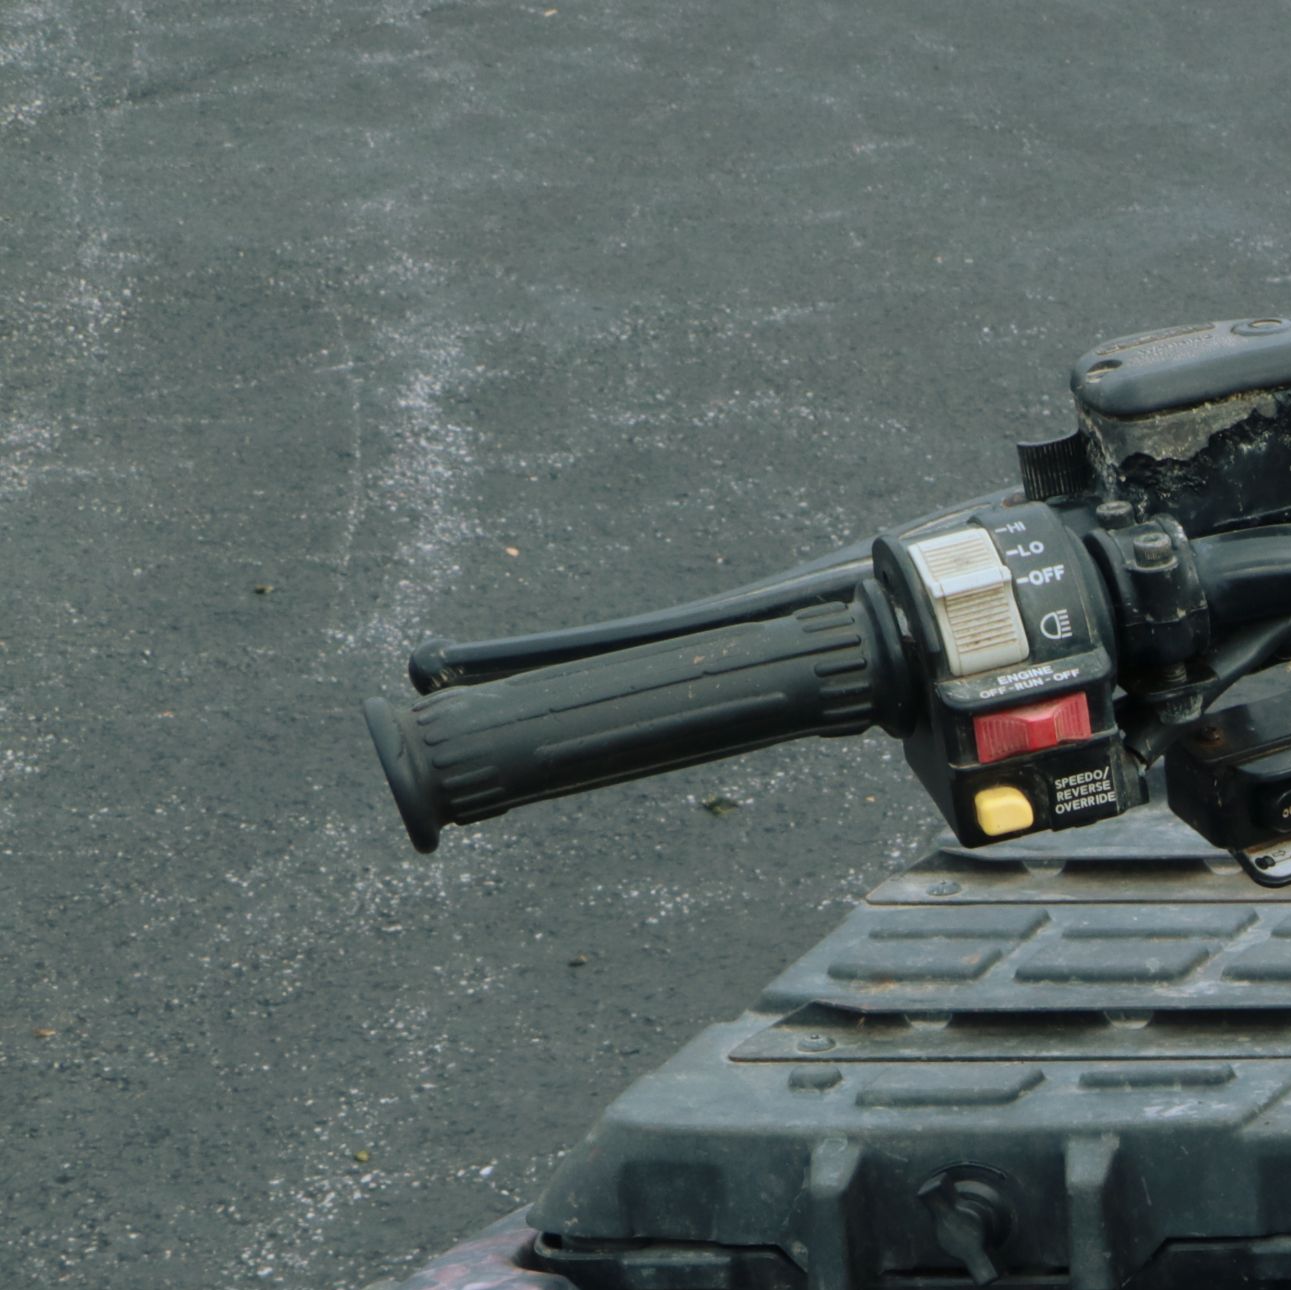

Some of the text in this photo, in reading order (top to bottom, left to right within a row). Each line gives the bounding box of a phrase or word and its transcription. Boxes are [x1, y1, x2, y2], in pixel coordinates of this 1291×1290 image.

[997, 665, 1053, 685] ENGINE
[1055, 766, 1109, 789] SPEEDO/
[1056, 780, 1111, 802] REVERSE
[1055, 791, 1117, 814] OVERRIDE
